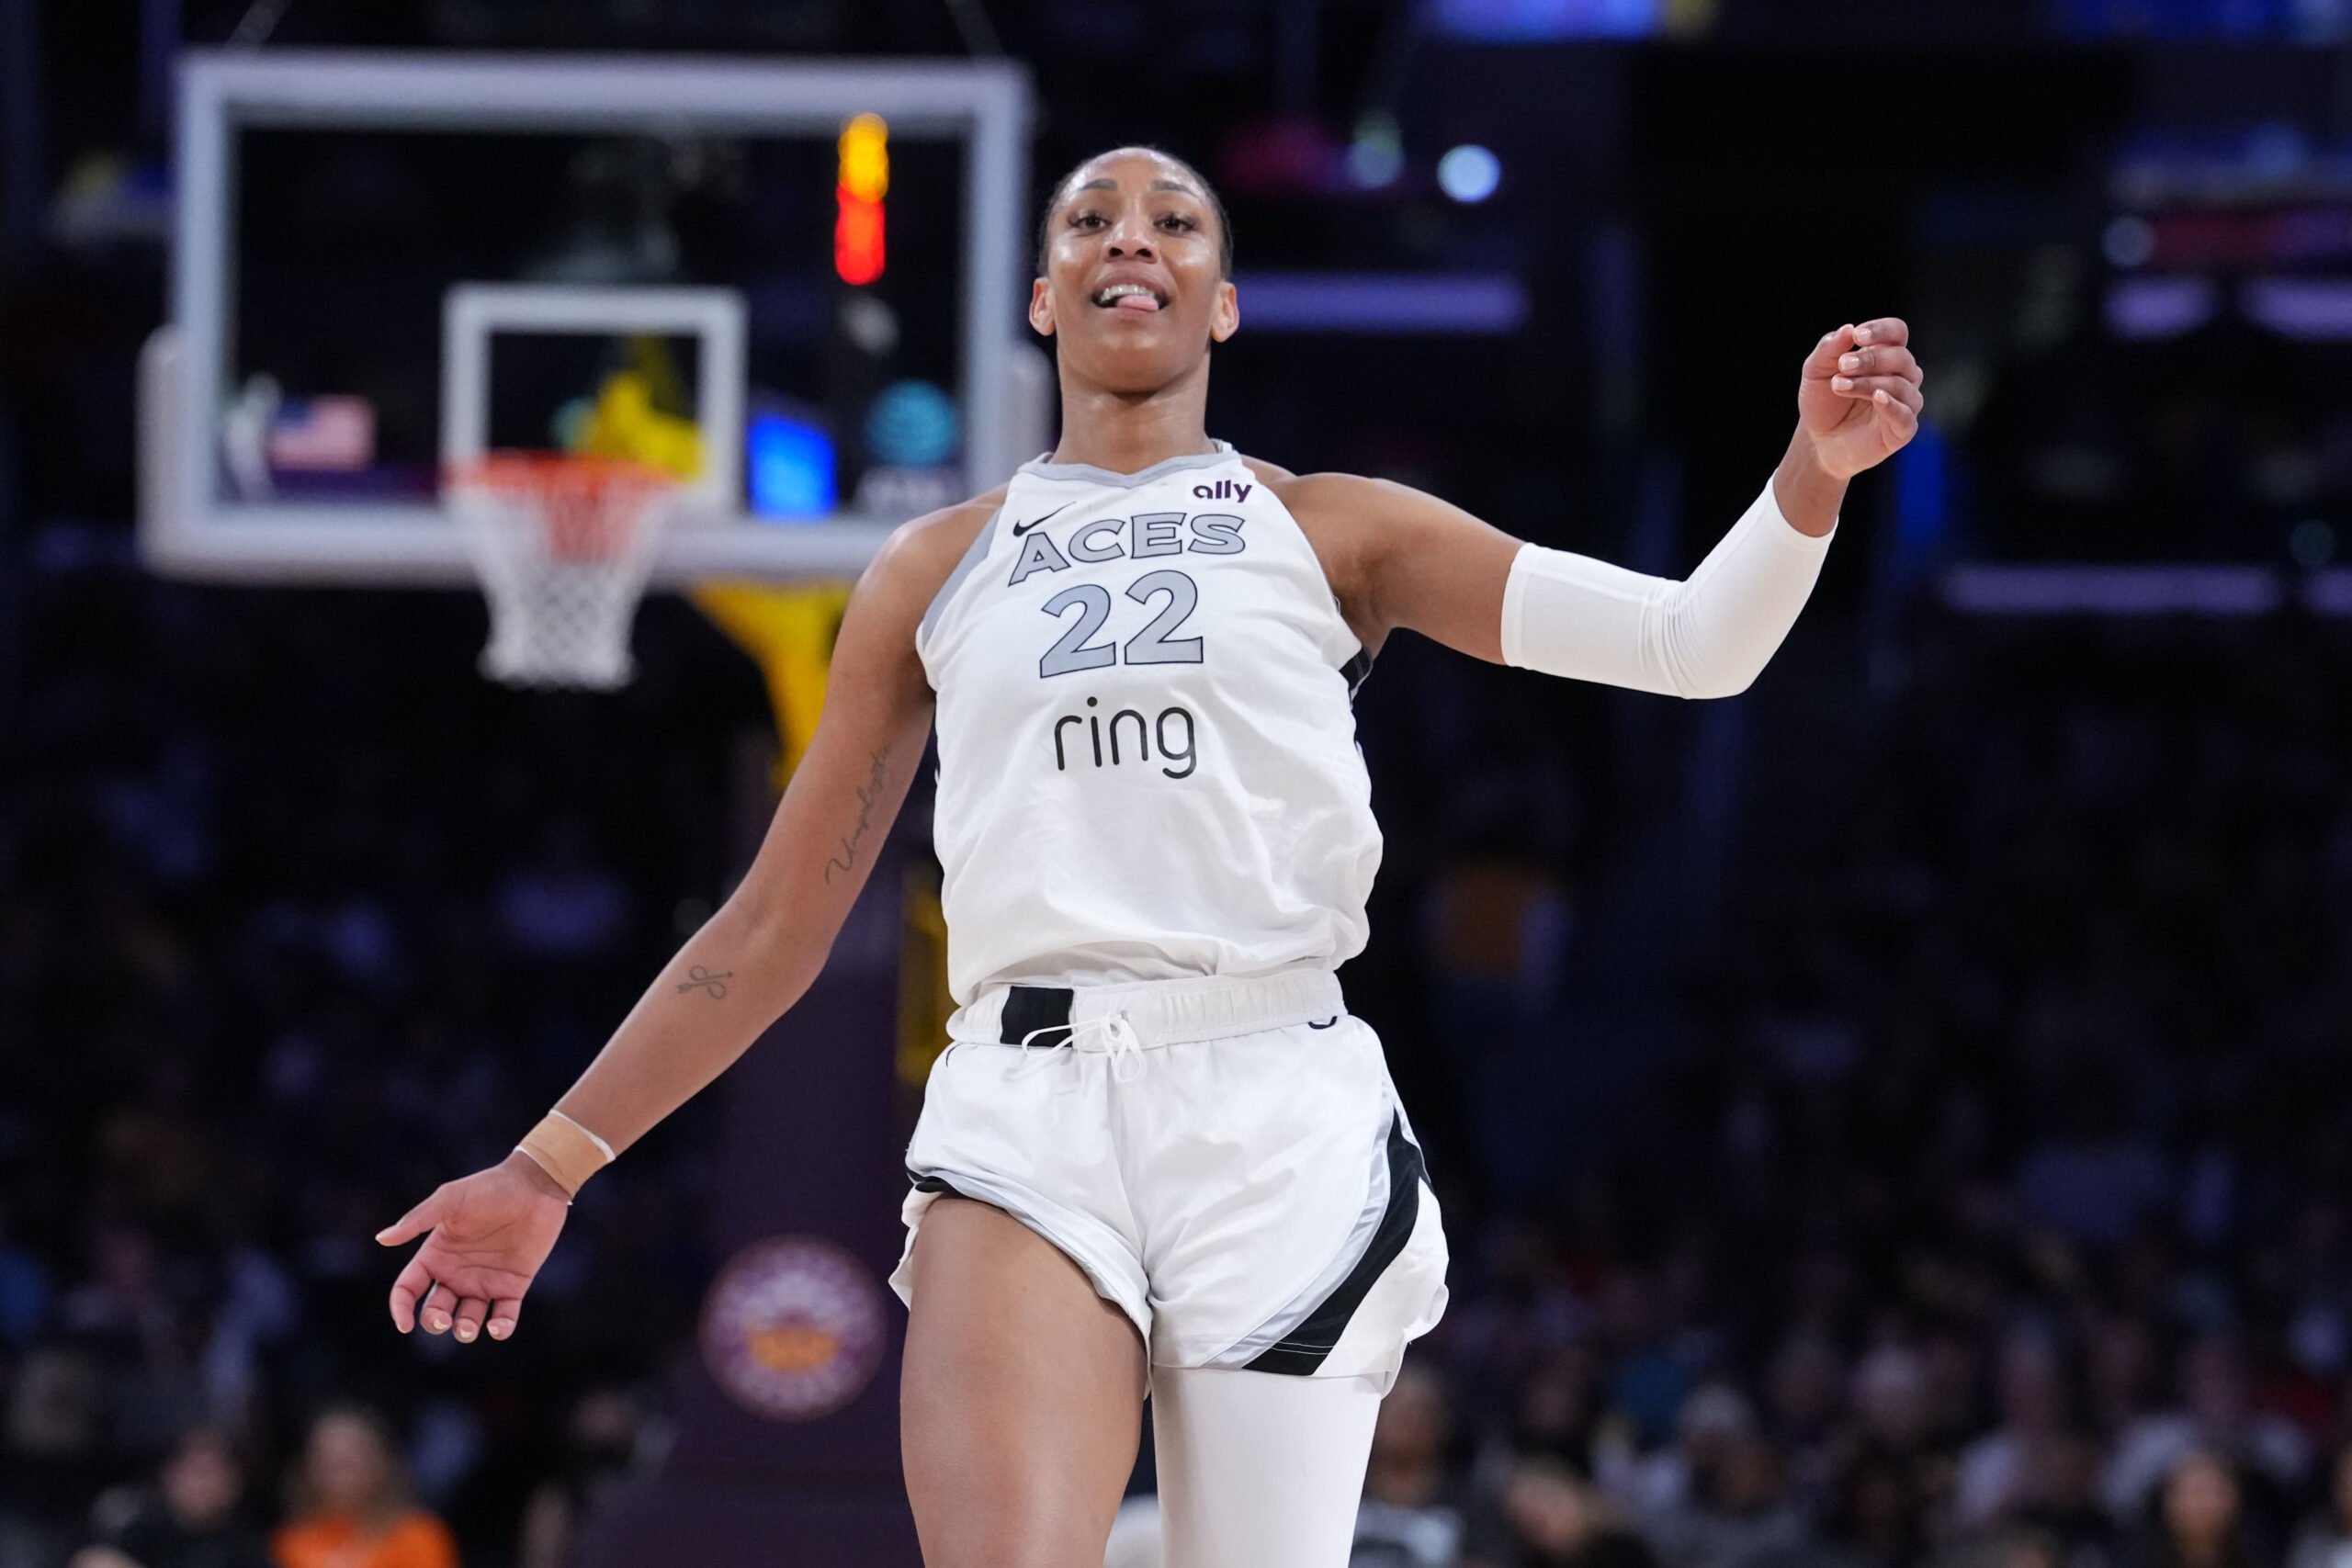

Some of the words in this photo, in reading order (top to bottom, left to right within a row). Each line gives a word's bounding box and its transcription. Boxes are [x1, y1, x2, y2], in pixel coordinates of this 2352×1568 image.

[1193, 479, 1252, 503] ally
[1008, 513, 1246, 587] ACES
[1039, 570, 1204, 678] 22
[1054, 696, 1196, 779] ring
